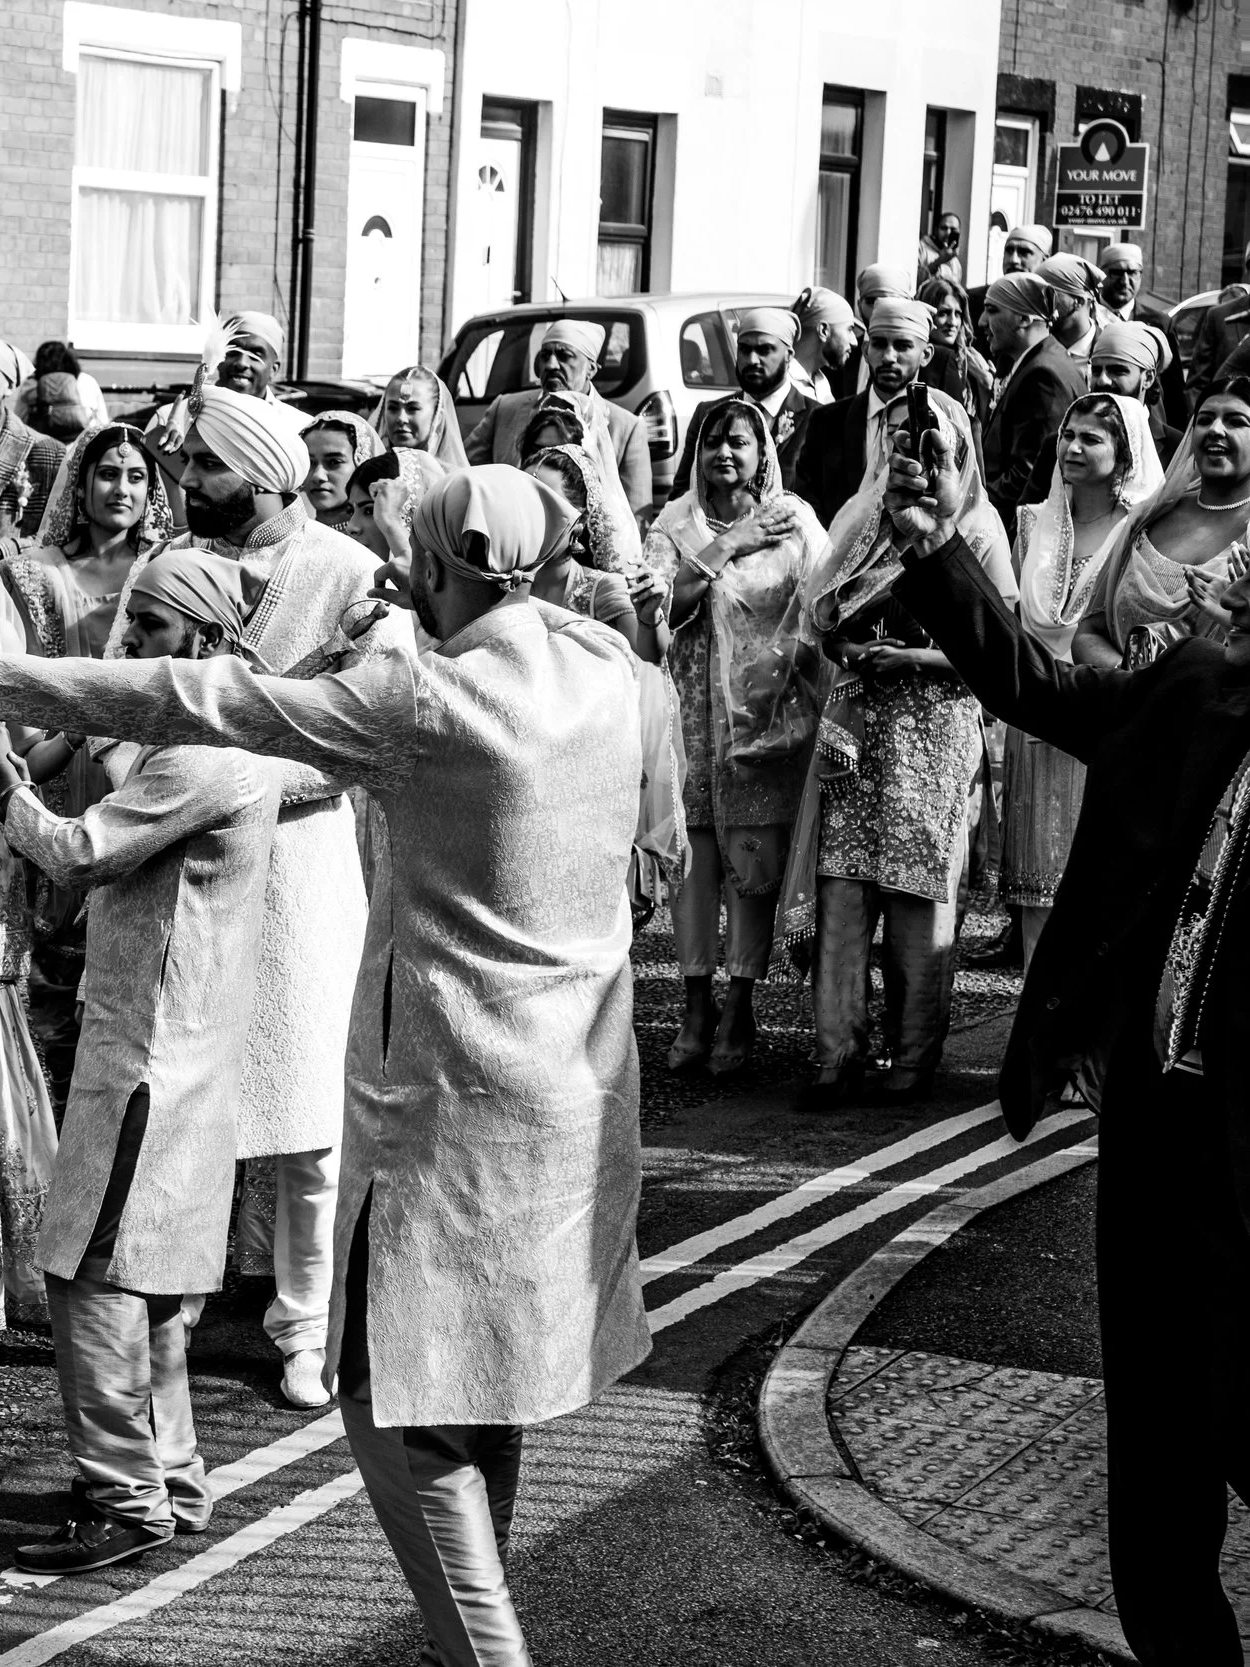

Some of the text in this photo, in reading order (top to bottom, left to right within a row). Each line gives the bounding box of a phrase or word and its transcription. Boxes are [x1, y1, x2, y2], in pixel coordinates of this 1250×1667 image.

[1067, 169, 1137, 182] YOUR MOVE
[1078, 193, 1122, 205] TO LET
[1061, 205, 1136, 217] 02476 490 011
